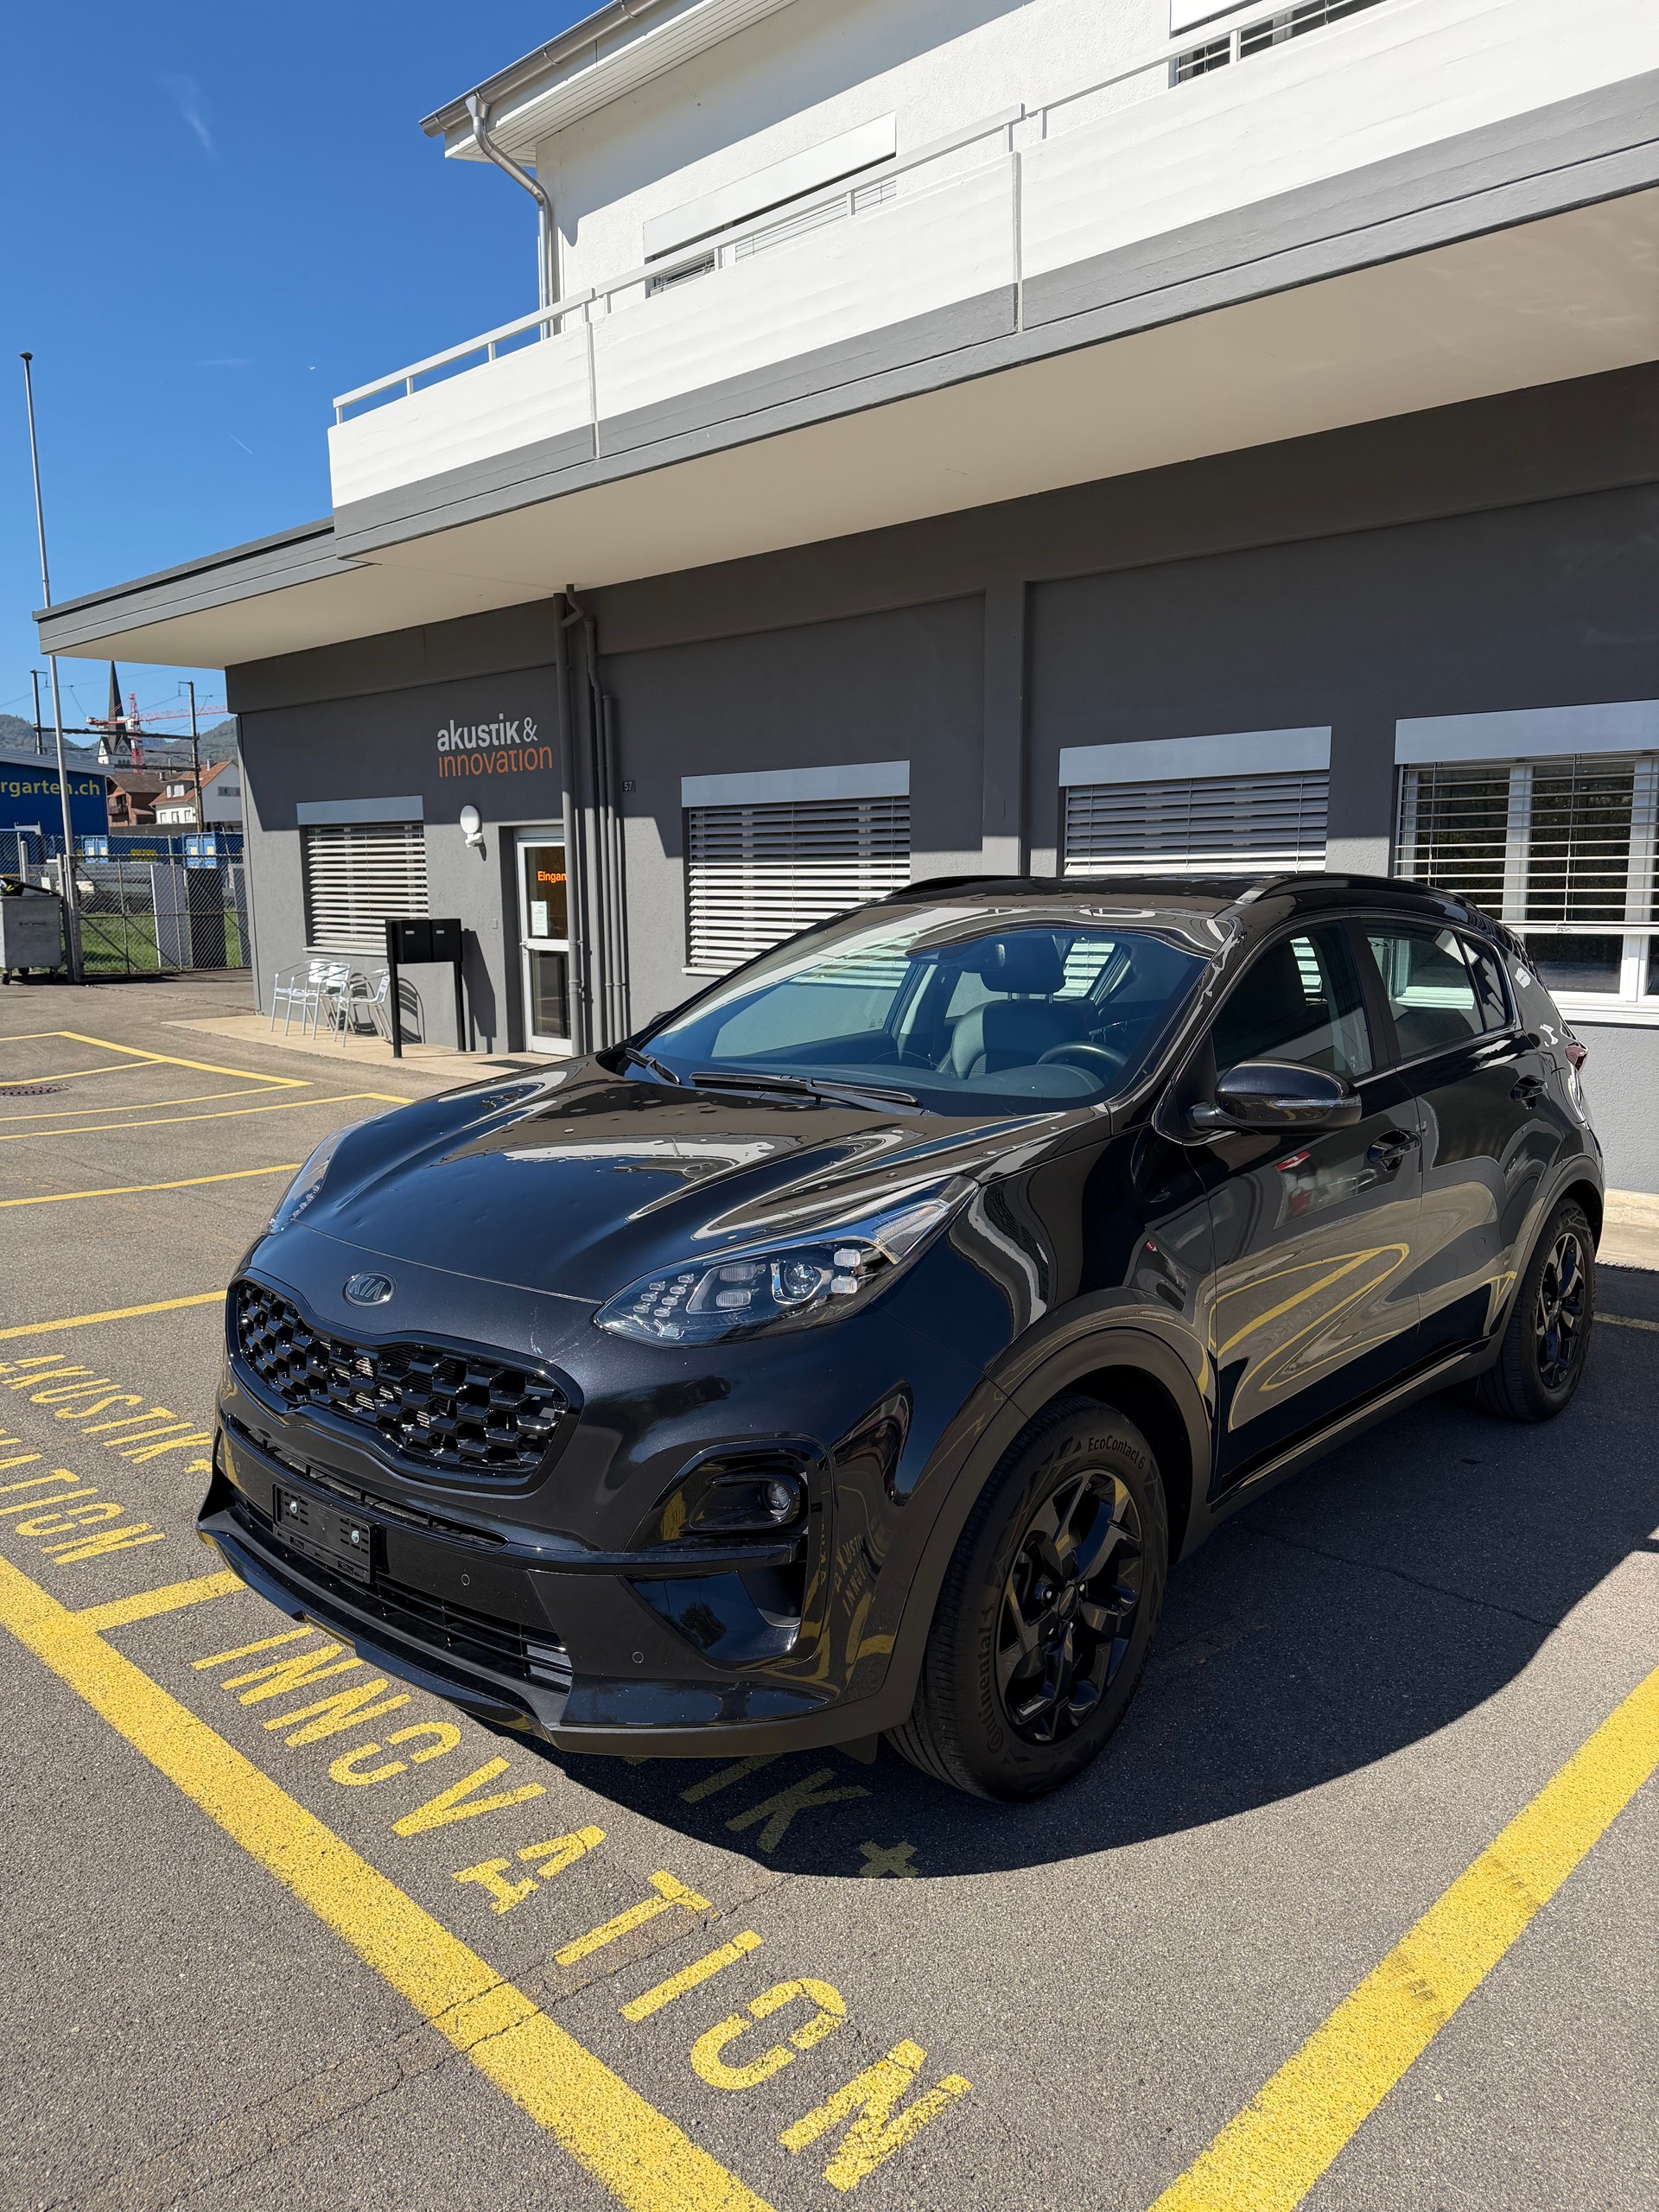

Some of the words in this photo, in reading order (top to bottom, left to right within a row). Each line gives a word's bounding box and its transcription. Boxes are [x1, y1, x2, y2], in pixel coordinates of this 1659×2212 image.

[438, 746, 553, 778] innovation
[624, 780, 632, 791] 57
[349, 1275, 386, 1300] KIA
[0, 1354, 213, 1464] AKUSTIK
[1087, 1434, 1140, 1464] EcoContact
[1138, 1456, 1146, 1470] 6
[978, 1625, 1003, 1754] Continental
[622, 1751, 873, 1853] IK
[190, 1625, 974, 2193] INNOVATION
